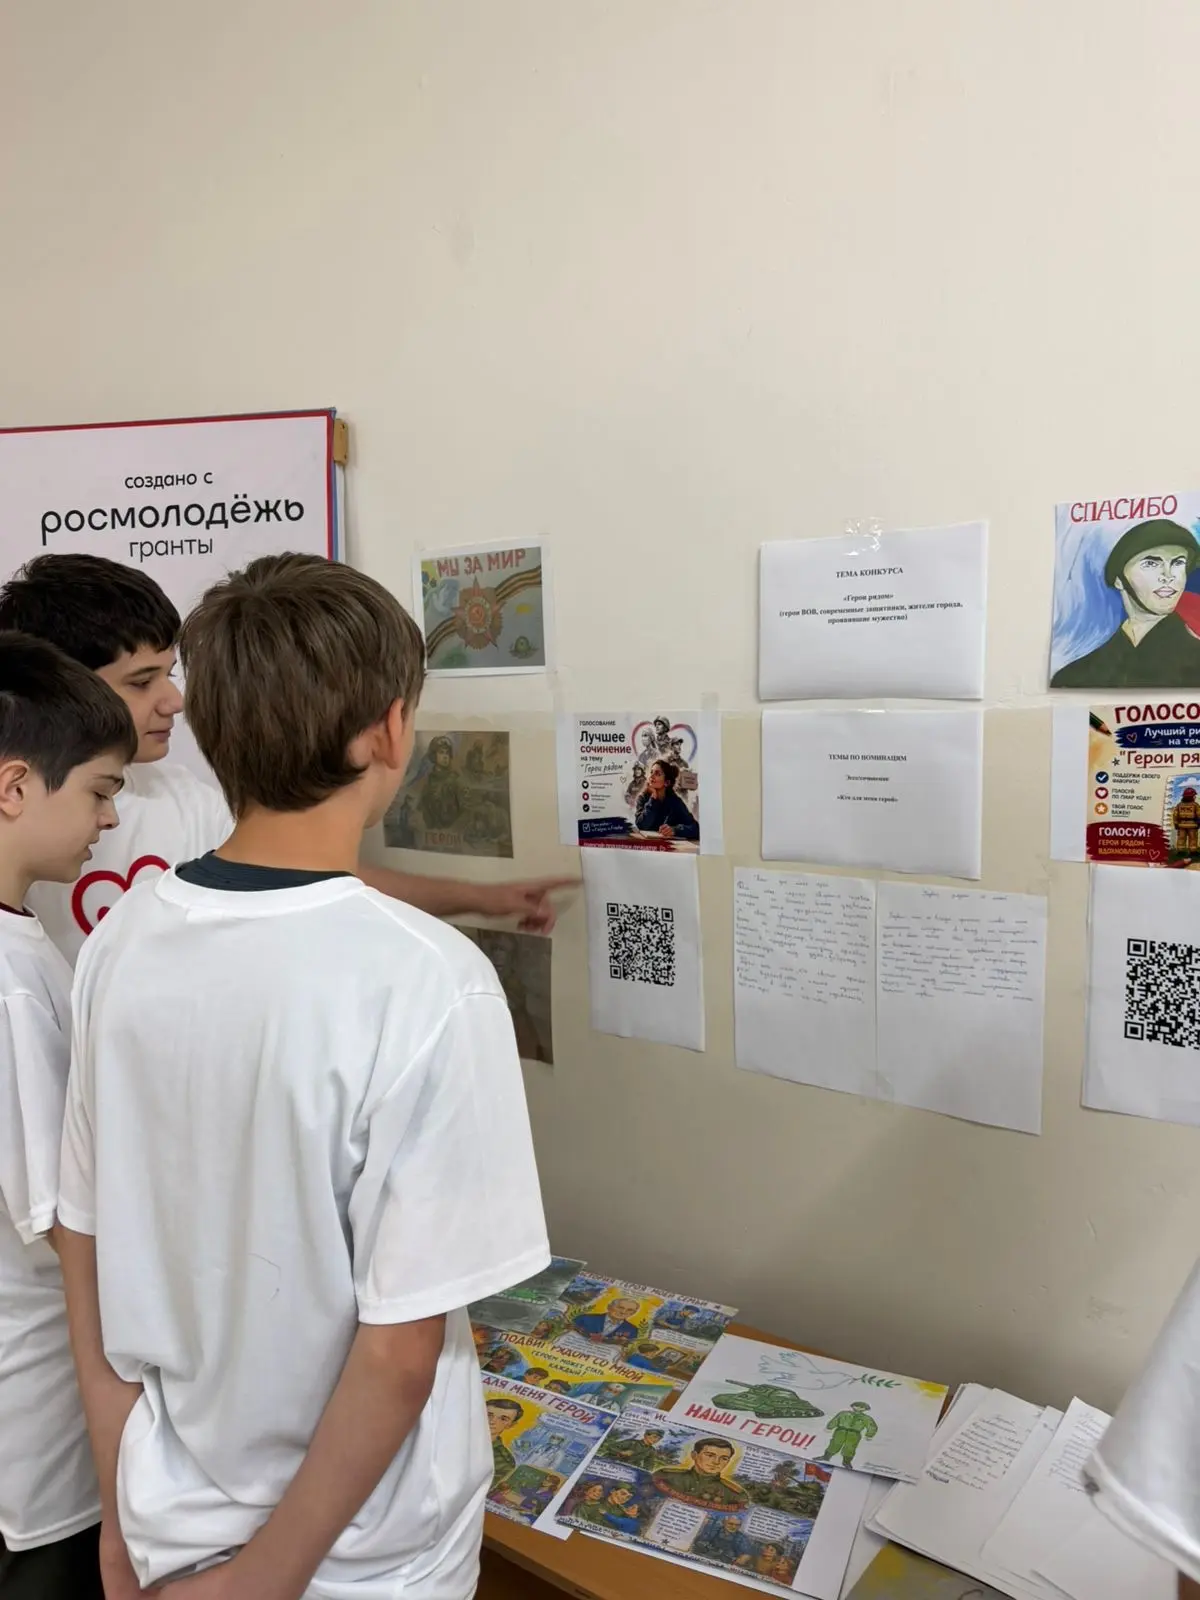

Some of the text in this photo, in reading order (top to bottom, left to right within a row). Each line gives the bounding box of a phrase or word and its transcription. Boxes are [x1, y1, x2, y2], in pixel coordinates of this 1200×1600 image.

[124, 472, 214, 490] создано с
[1070, 494, 1178, 522] СПАСИБО
[41, 494, 304, 546] росмолодёжь
[129, 538, 214, 562] гранты
[437, 548, 525, 577] МЫ ЗА МИР
[836, 566, 904, 579] ТЕМА КОНКУРСА
[1115, 703, 1200, 724] ГОЛОСО
[580, 731, 625, 745] Лучшее
[1144, 726, 1186, 739] Лучший
[580, 745, 632, 754] сочинение
[482, 1376, 596, 1423] ДЛЯ МЕНЯ ГЕРОЙ
[684, 1403, 737, 1426] НАШИ
[739, 1419, 817, 1450] ГЕРОИ!
